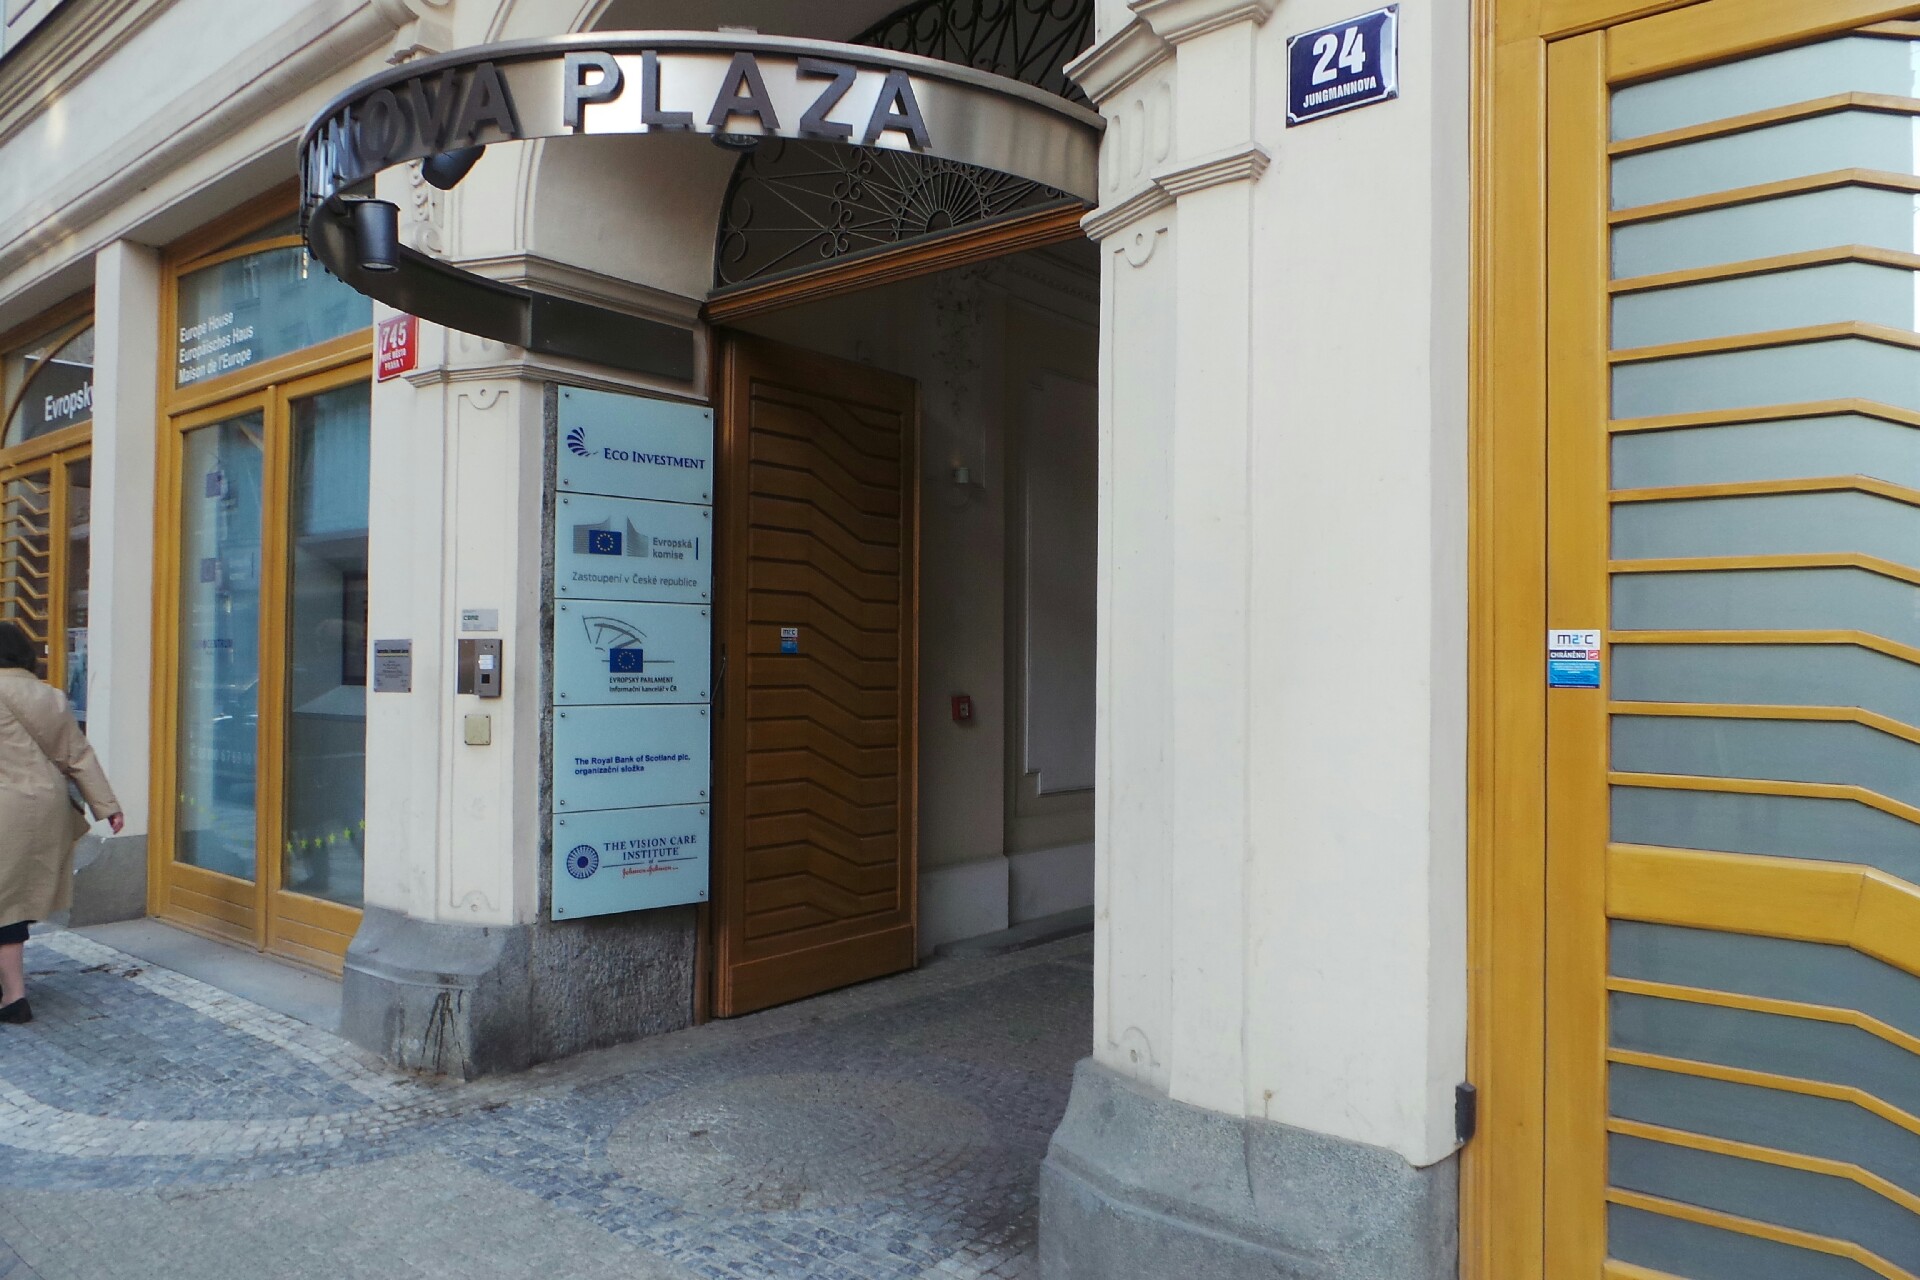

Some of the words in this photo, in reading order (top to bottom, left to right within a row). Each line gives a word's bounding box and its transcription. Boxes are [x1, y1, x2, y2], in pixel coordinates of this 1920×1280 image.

[1311, 26, 1366, 86] 24
[563, 49, 932, 150] PLAZA
[1302, 75, 1377, 108] JUNGMANNOVA
[180, 322, 207, 343] Europe
[208, 312, 234, 332] House
[382, 320, 407, 352] 745
[180, 334, 231, 364] Europäisches
[232, 325, 254, 344] Haus
[179, 365, 206, 384] Maison
[207, 359, 217, 374] de
[218, 348, 252, 371] l'Europe
[385, 359, 400, 371] PRAHA
[652, 537, 693, 550] Evropská
[652, 549, 684, 560] komise
[572, 571, 622, 585] Zastoupení
[632, 573, 658, 586] České
[660, 576, 698, 588] republice
[640, 676, 673, 684] PARLAMENT
[574, 757, 589, 765] The
[591, 756, 613, 766] Royal
[614, 755, 634, 764] Bank
[635, 755, 644, 763] of
[645, 753, 676, 763] Scotland
[603, 841, 627, 852] THE
[629, 837, 667, 849] VISION
[669, 834, 697, 846] CARE
[622, 847, 679, 861] INSTITUTE
